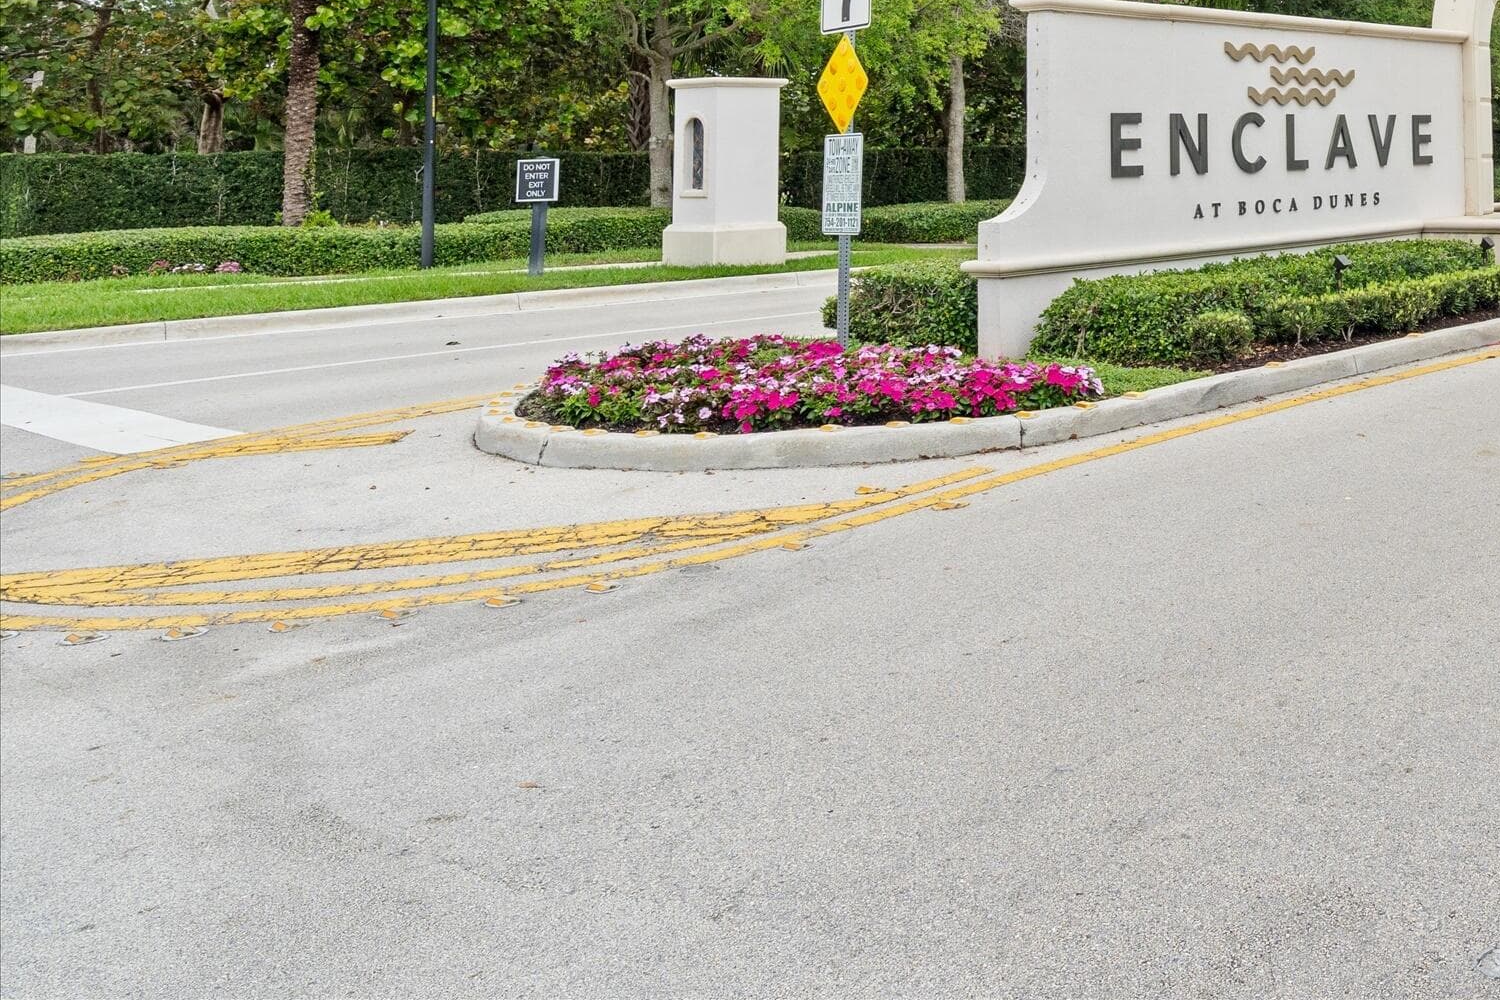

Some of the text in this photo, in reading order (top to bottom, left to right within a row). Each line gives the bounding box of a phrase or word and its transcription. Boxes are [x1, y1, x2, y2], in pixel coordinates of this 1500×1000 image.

[1110, 112, 1433, 178] ENCLAVE
[836, 157, 850, 173] ZONE
[525, 172, 549, 180] ENTER
[825, 202, 859, 213] ALPINE
[1193, 191, 1381, 219] AT BOCA DUNES
